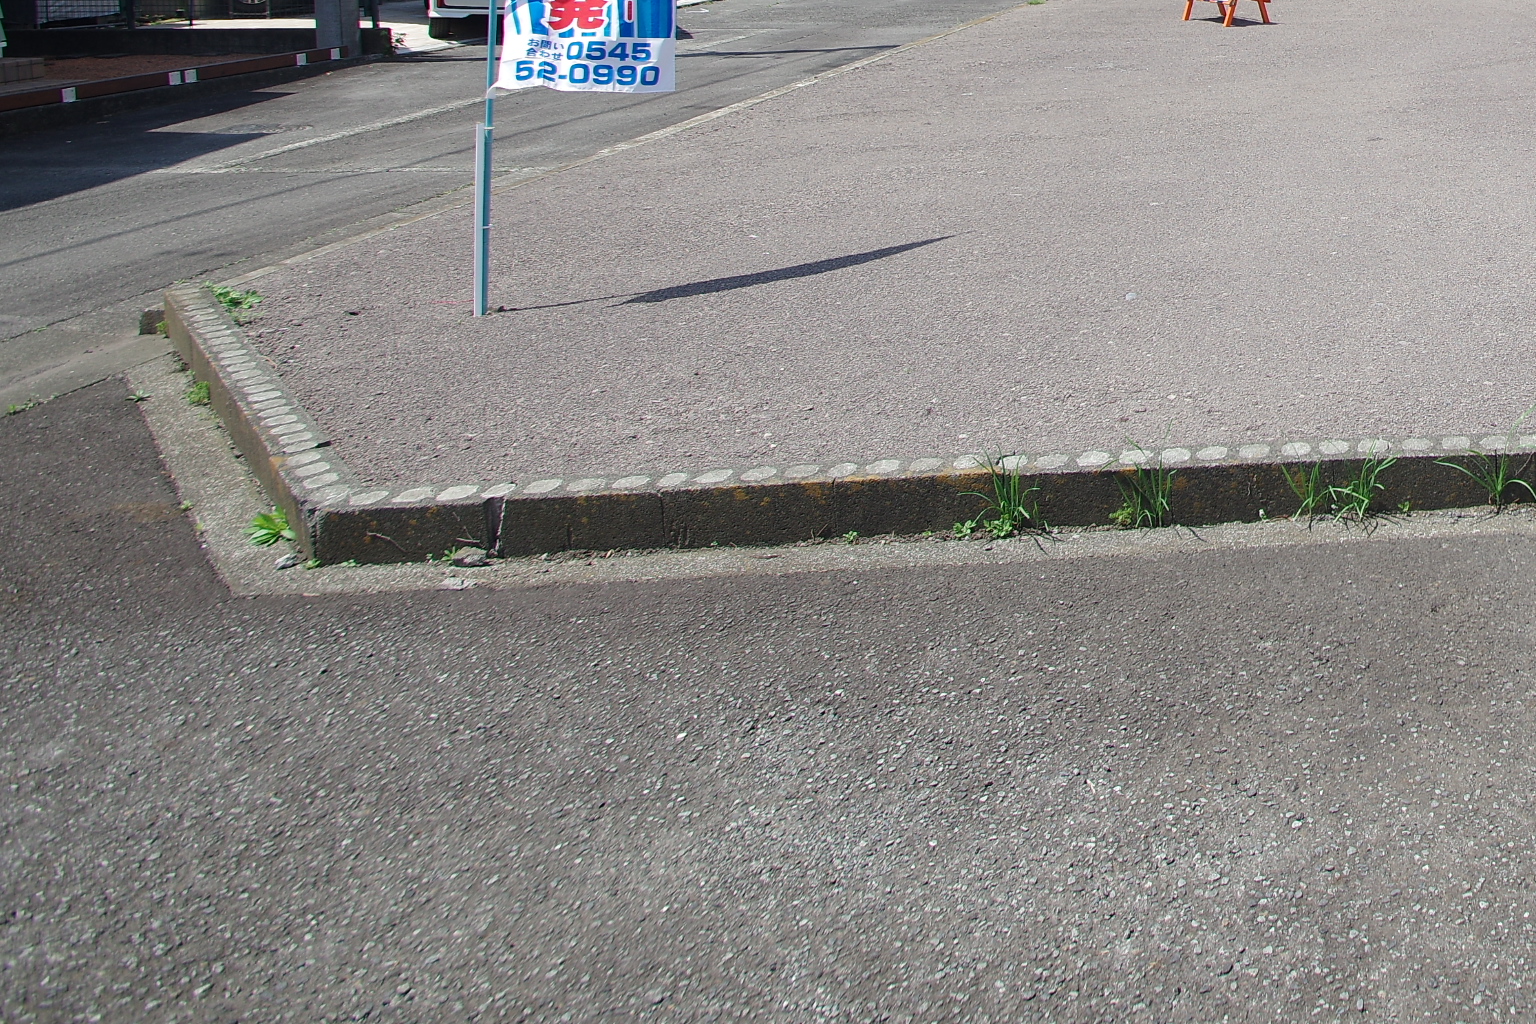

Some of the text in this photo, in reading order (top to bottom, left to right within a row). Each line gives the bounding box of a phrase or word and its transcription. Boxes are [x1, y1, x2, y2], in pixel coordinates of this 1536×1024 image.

[527, 38, 565, 51] お問い
[566, 41, 651, 62] 0545
[526, 47, 564, 61] 合わせ
[515, 60, 661, 86] 52-0990
